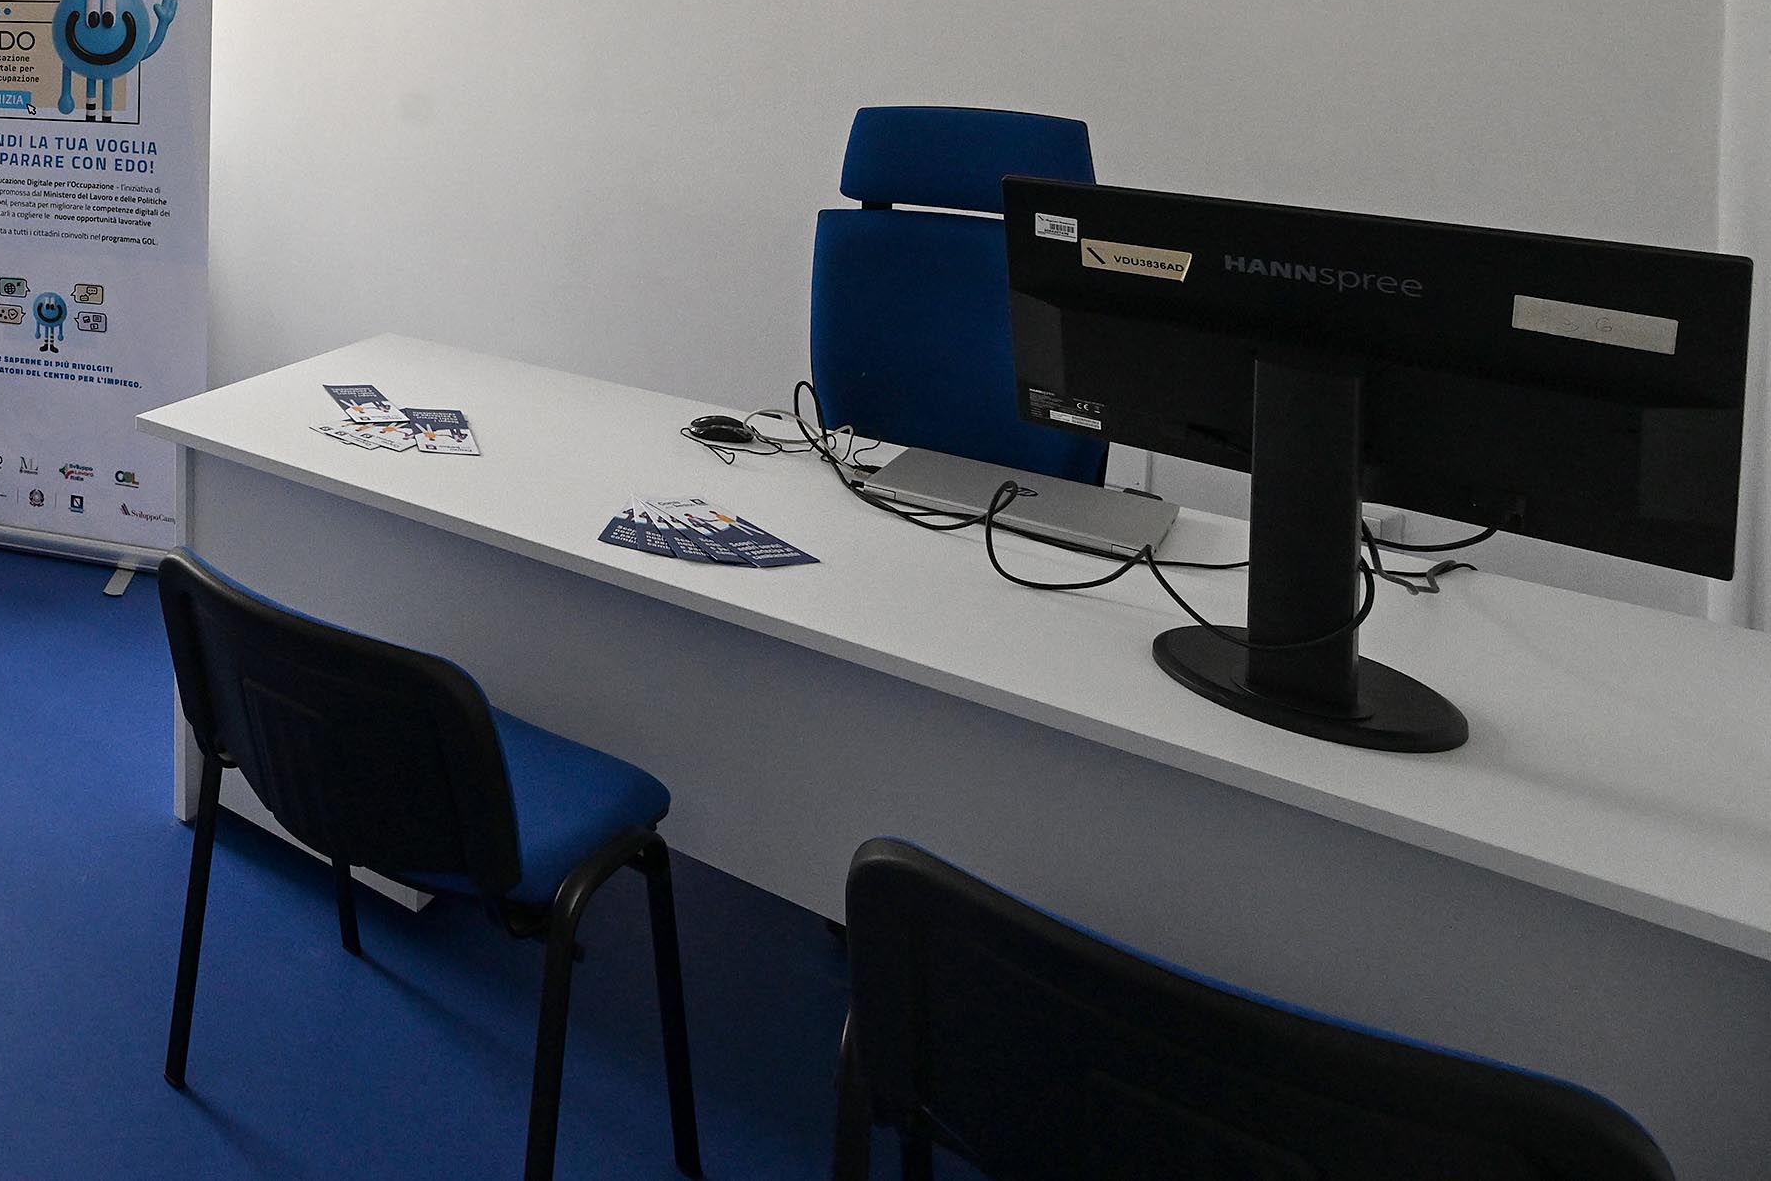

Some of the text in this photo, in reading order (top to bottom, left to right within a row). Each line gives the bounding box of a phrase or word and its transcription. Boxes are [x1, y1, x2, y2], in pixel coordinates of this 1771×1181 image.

[19, 66, 35, 74] per
[30, 135, 49, 149] LA
[54, 137, 88, 151] TUA
[95, 138, 158, 155] VOGLIA
[71, 156, 107, 171] CON
[114, 158, 154, 174] EDO!
[27, 178, 53, 188] Digitale
[54, 181, 65, 189] per
[67, 180, 114, 191] l'Occupazione
[154, 186, 161, 194] di
[0, 189, 29, 197] promossa
[31, 189, 42, 197] dal
[44, 190, 76, 199] Ministero
[90, 193, 113, 201] Lavoro
[120, 195, 136, 203] delle
[137, 196, 167, 205] Politiche
[10, 200, 36, 208] pensata
[37, 202, 49, 210] per
[50, 202, 84, 211] migliorare
[85, 203, 91, 211] le
[92, 205, 133, 214] competenze
[135, 207, 159, 217] digitali
[16, 211, 43, 220] cogliere
[76, 214, 117, 224] opportunità
[118, 217, 152, 227] lavorative
[14, 228, 29, 236] tutti
[33, 229, 60, 238] cittadini
[61, 231, 89, 240] coinvolti
[90, 233, 101, 241] nel
[101, 234, 141, 244] programma
[1113, 255, 1185, 273] VDU3836AD
[1224, 254, 1423, 298] HANNspree
[4, 356, 42, 366] SAPERNE
[43, 359, 53, 367] DI
[55, 359, 70, 369] PIÙ
[72, 362, 113, 373] RIVOLGITI
[26, 369, 41, 378] DEL
[43, 371, 76, 381] CENTRO
[78, 374, 94, 383] PER
[97, 376, 143, 389] L'IMPIEGO.
